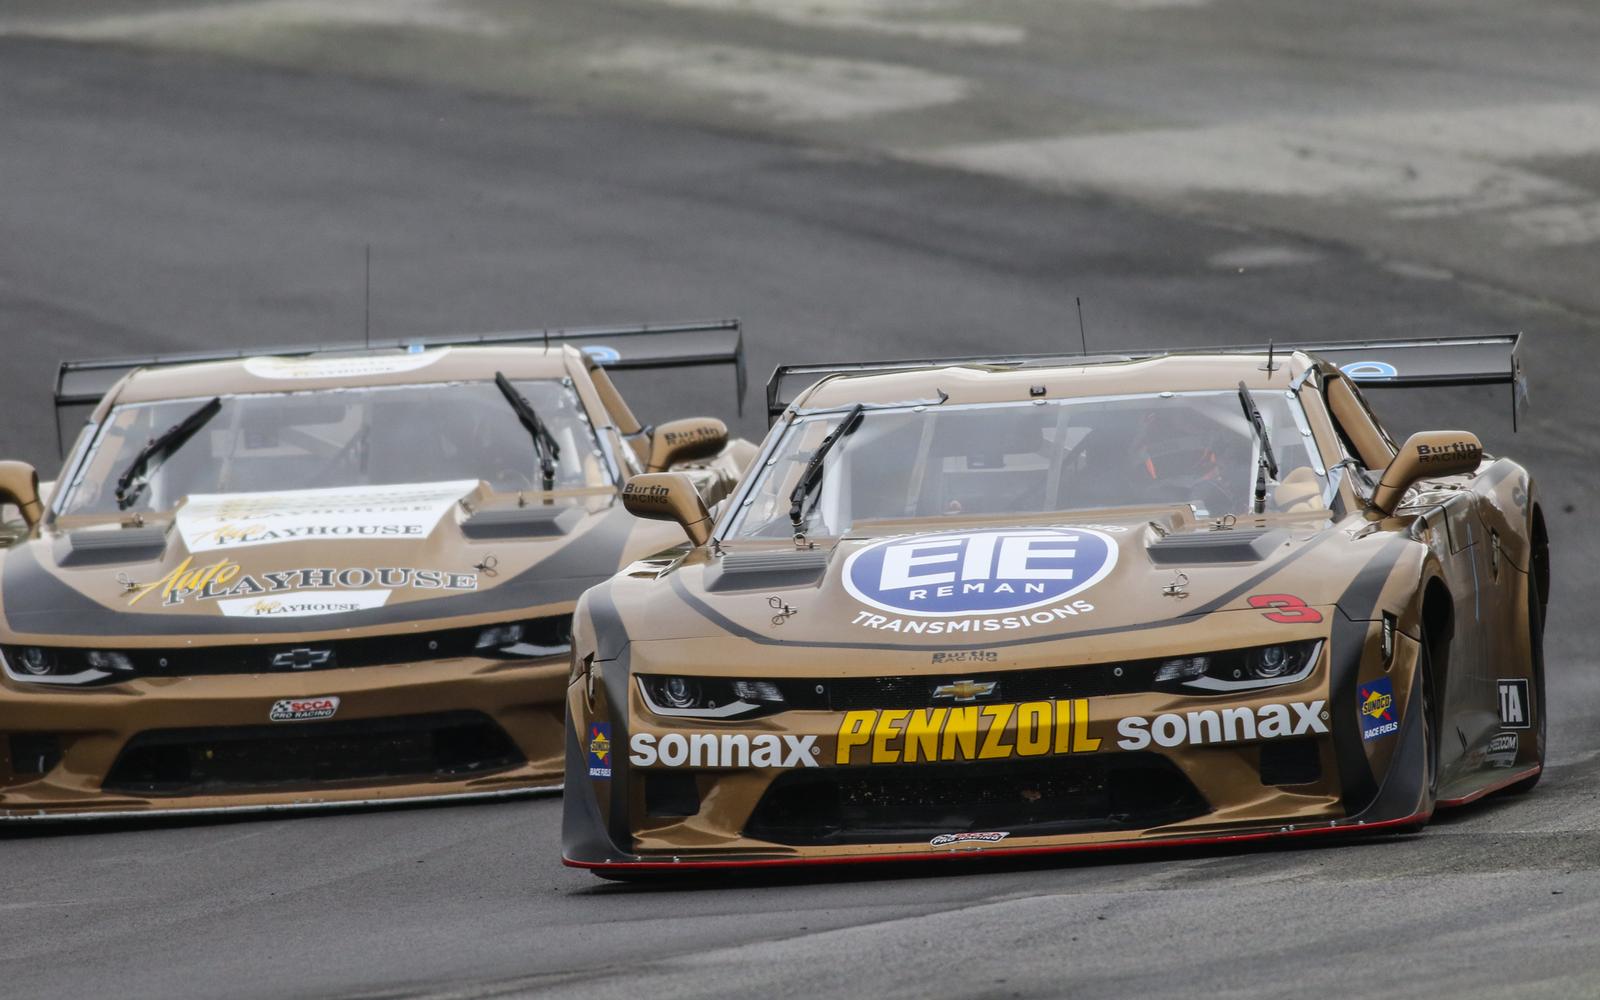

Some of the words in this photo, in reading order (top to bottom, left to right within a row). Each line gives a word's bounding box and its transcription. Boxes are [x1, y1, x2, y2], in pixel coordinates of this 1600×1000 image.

[1417, 441, 1477, 455] Burtin
[1419, 451, 1477, 463] RACING
[623, 493, 669, 504] RACING
[624, 483, 669, 496] Burtin
[217, 524, 423, 545] PLAYHOUSE
[879, 531, 1079, 591] ETE
[129, 554, 241, 606] Auto
[162, 567, 478, 607] PLAYHOUSE
[909, 582, 1045, 601] REMAN
[255, 602, 361, 616] PLAYHOUSE
[851, 599, 1095, 634] TRANSMISSIONS
[1246, 593, 1324, 624] 3
[932, 650, 998, 659] Burtin
[291, 700, 333, 712] SCCA
[1362, 695, 1391, 715] SUNOCO
[1499, 685, 1523, 722] TA
[272, 711, 293, 720] PRO
[296, 710, 333, 719] RACING
[834, 698, 1102, 765] PENNZOIL
[1364, 727, 1379, 740] RACE
[1380, 721, 1398, 735] FUELS
